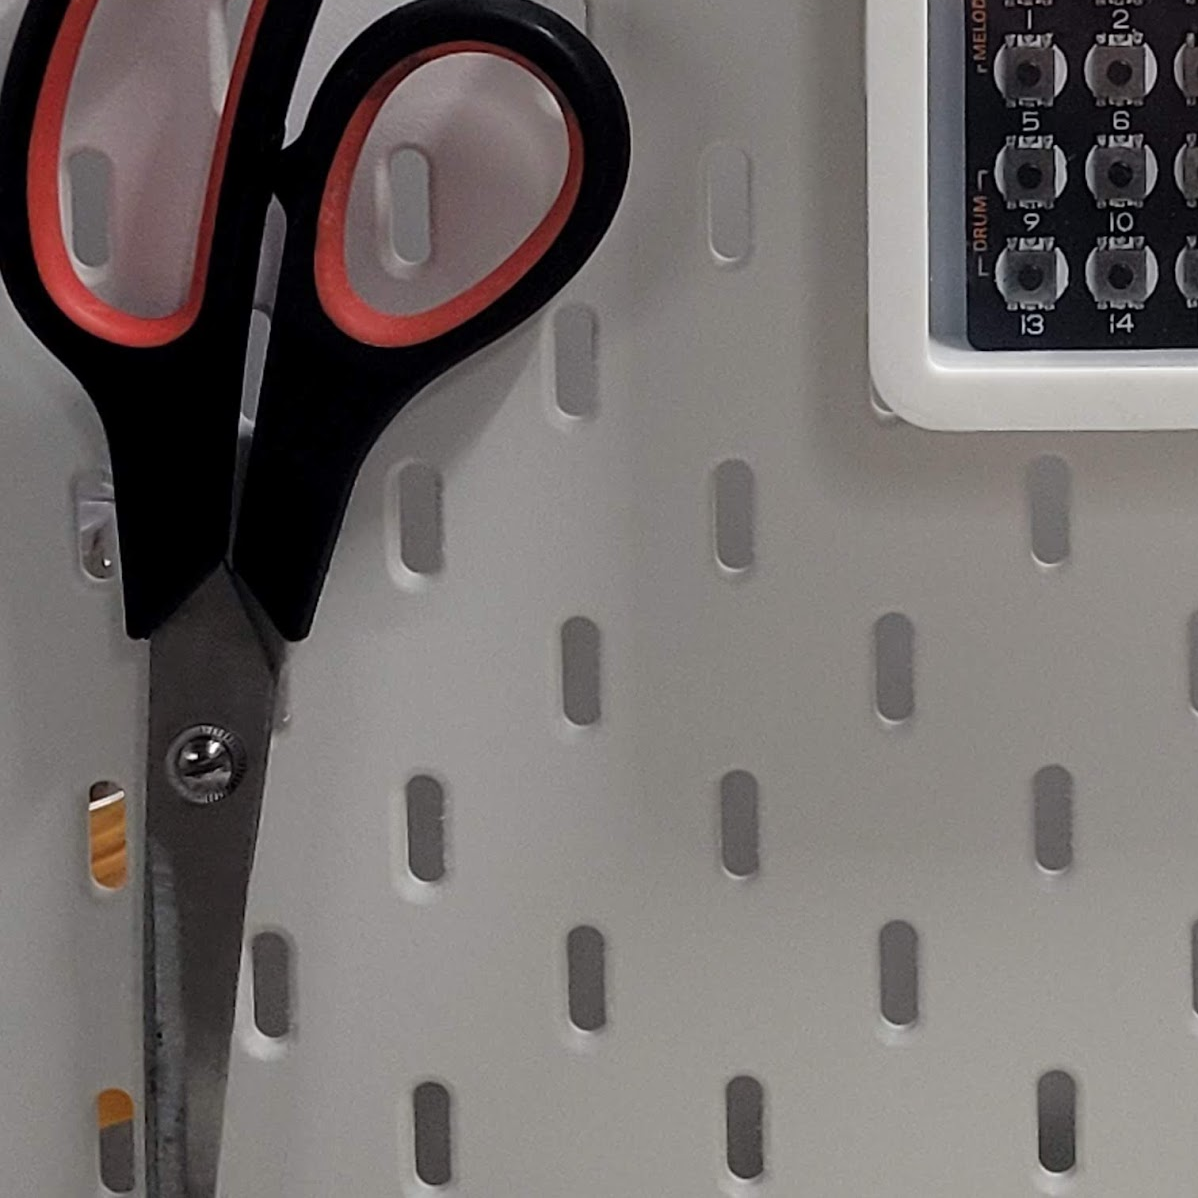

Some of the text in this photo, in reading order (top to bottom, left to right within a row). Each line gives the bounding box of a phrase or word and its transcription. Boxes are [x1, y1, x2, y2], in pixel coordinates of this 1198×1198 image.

[1026, 9, 1033, 30] 1
[1112, 9, 1130, 30] 2
[1023, 112, 1039, 131] 5
[1113, 111, 1129, 130] 6
[973, 196, 987, 252] DRUM
[1024, 213, 1039, 231] 9
[1110, 212, 1133, 232] 10
[1022, 314, 1043, 334] 13
[1110, 313, 1134, 333] 14
